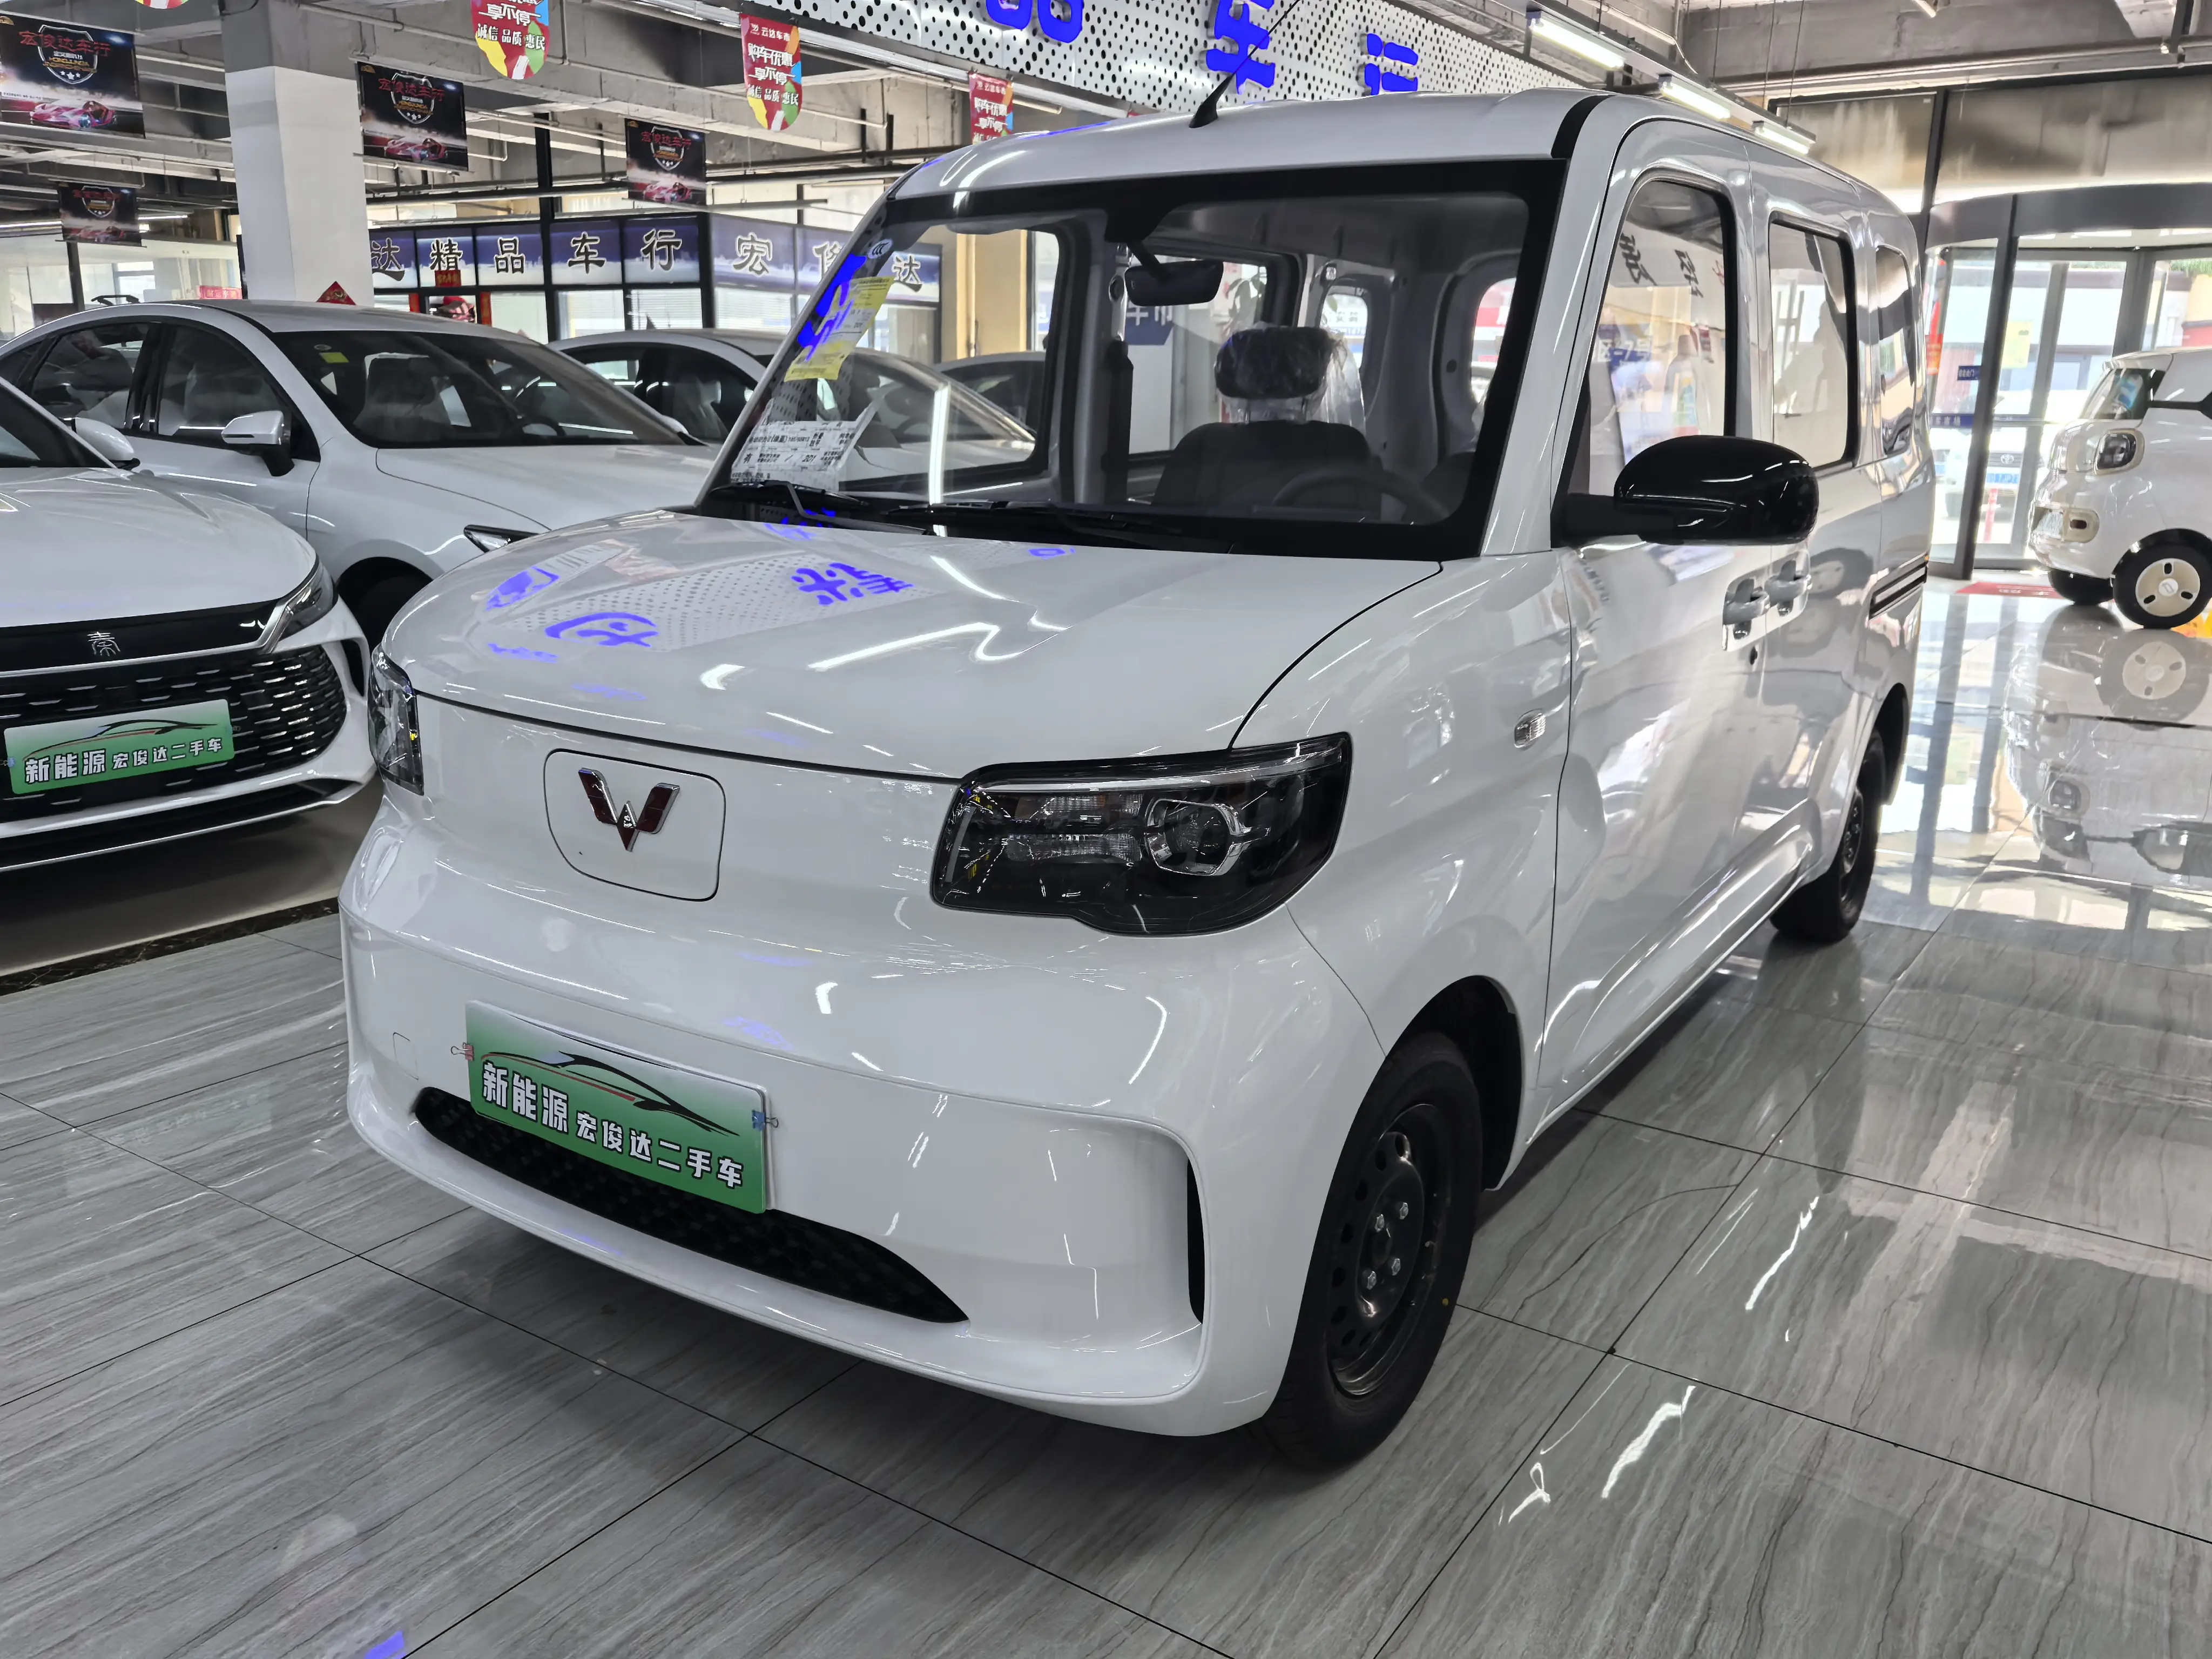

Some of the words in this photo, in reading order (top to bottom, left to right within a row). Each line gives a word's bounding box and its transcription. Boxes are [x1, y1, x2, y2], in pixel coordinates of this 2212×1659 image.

[478, 3, 541, 26] 享不停
[477, 23, 498, 41] 诚信
[502, 29, 523, 46] 品质
[525, 34, 545, 51] 惠民
[747, 43, 796, 67] 购车优惠
[747, 66, 796, 86] 享不停
[25, 748, 106, 785] 新能源
[112, 737, 223, 771] 宏俊达二手车
[482, 1061, 569, 1134] 新能源
[575, 1111, 745, 1189] 宏俊达二手车
